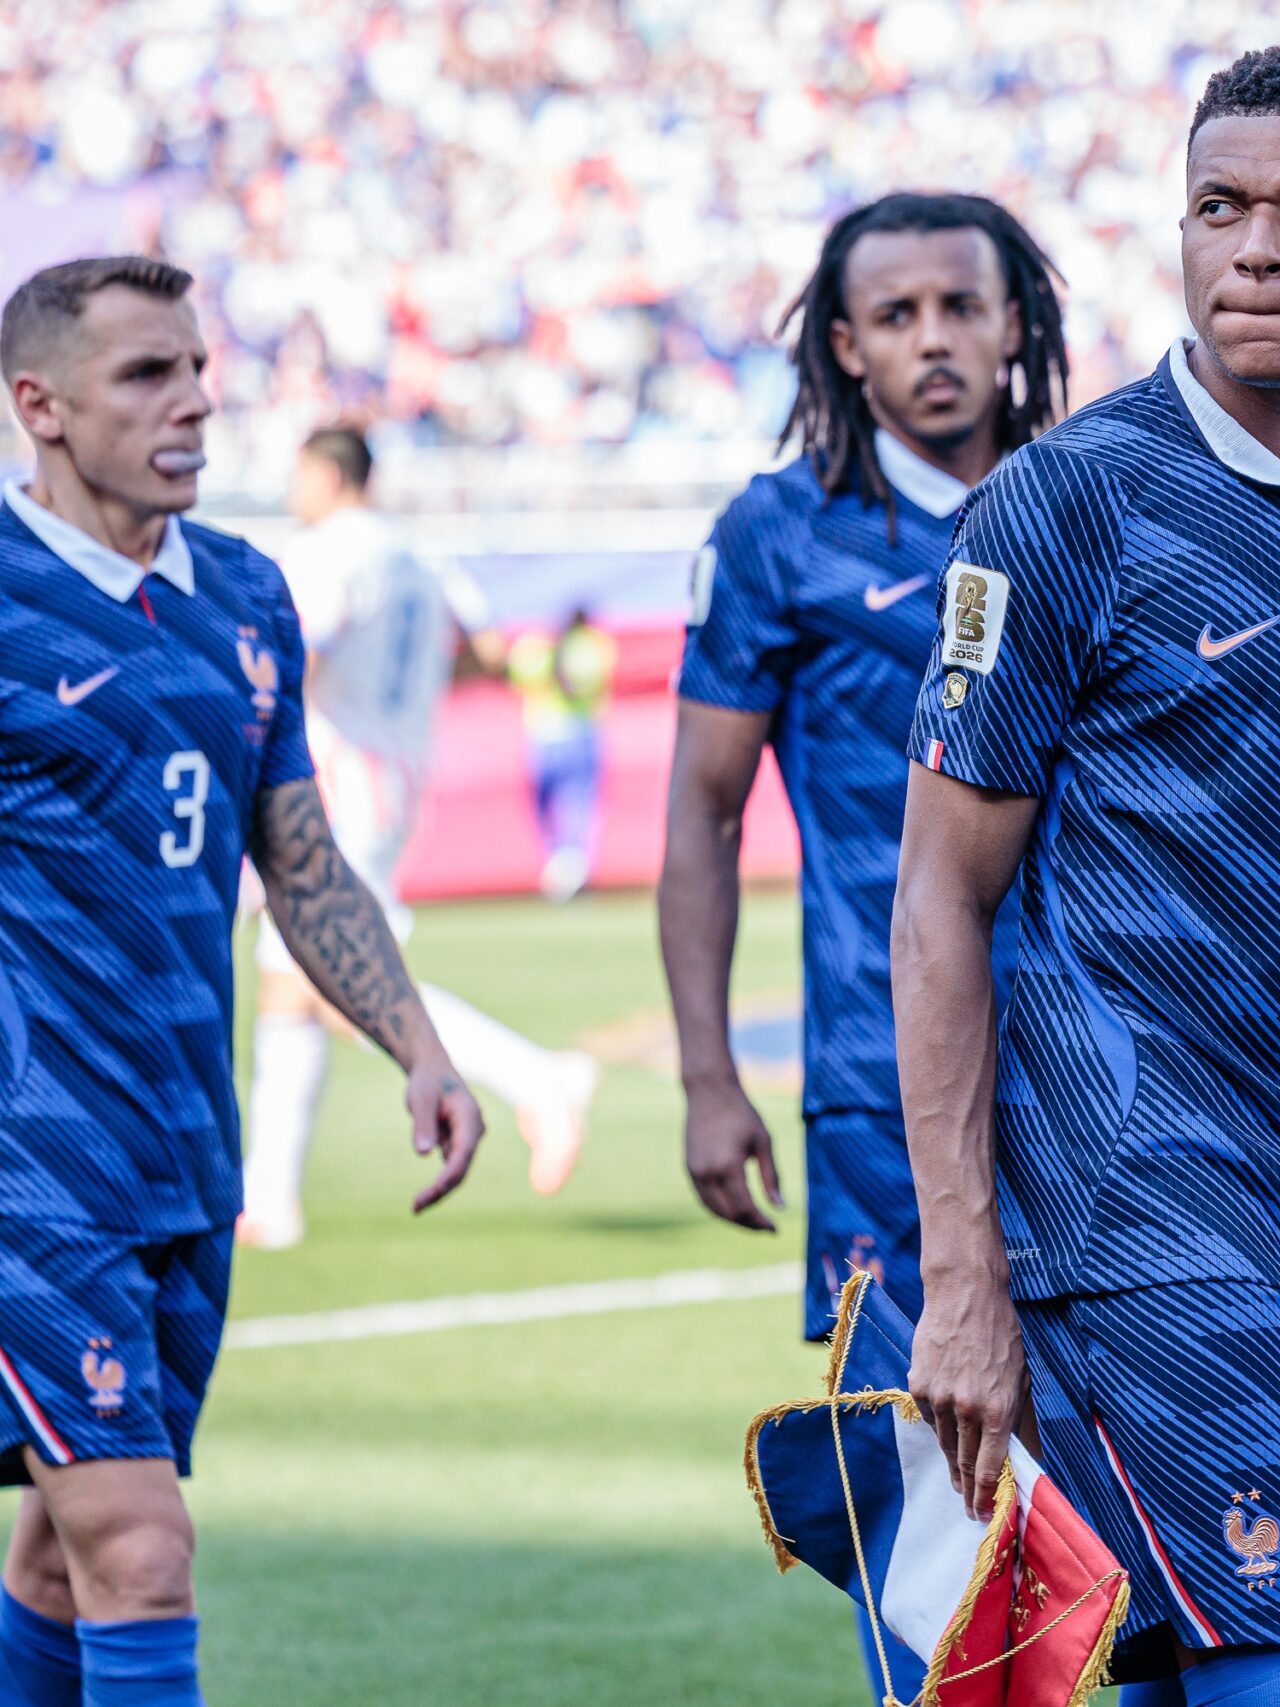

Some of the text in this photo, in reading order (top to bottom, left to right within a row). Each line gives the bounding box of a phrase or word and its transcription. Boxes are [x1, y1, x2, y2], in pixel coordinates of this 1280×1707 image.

[958, 627, 975, 637] FIFA
[949, 649, 983, 663] 2026
[159, 749, 211, 869] 3
[1007, 1248, 1040, 1260] ERO-FIT
[1247, 1577, 1276, 1592] FFF
